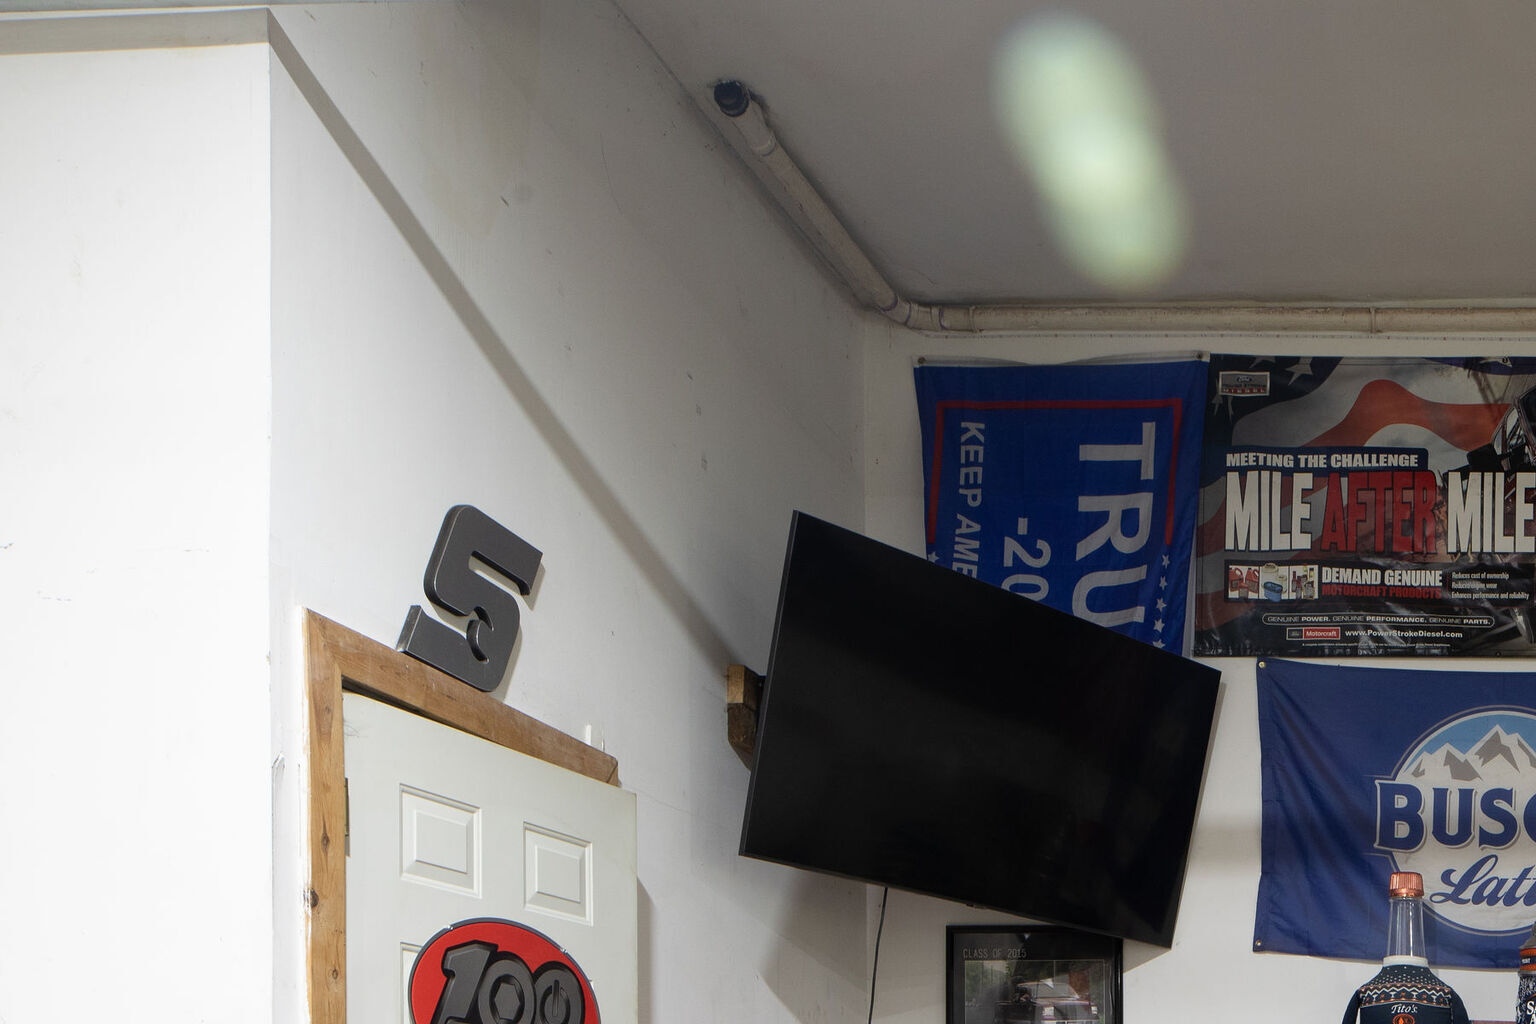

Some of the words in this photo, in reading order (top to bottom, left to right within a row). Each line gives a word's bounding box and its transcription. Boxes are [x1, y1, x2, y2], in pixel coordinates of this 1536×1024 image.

[959, 421, 986, 508] KEEP
[1225, 453, 1294, 469] MEETING
[1297, 454, 1327, 468] THE
[1330, 453, 1419, 468] CHALLENGE
[1225, 471, 1314, 551] MILE
[1321, 470, 1438, 553] AFTER
[1448, 471, 1536, 553] MILE
[1072, 420, 1157, 628] TRU
[952, 512, 982, 582] AME
[1000, 516, 1052, 602] -20
[1321, 566, 1381, 587] DEMAND
[1384, 569, 1443, 587] GENUINE
[1321, 584, 1387, 598] MOTORCRAFT
[1388, 586, 1443, 599] PRODUCTS
[1267, 615, 1300, 623] GENUINE
[1301, 615, 1331, 623] POWER.
[1332, 615, 1364, 623] GENUINE
[1366, 615, 1427, 624] PERFORMANCE.
[1305, 629, 1337, 638] Motorcraft
[1345, 628, 1463, 639] www.PowerStrokeDiesel.com
[962, 948, 989, 960] CLASS
[1007, 948, 1027, 959] 2015
[1390, 1003, 1418, 1014] Tito's
